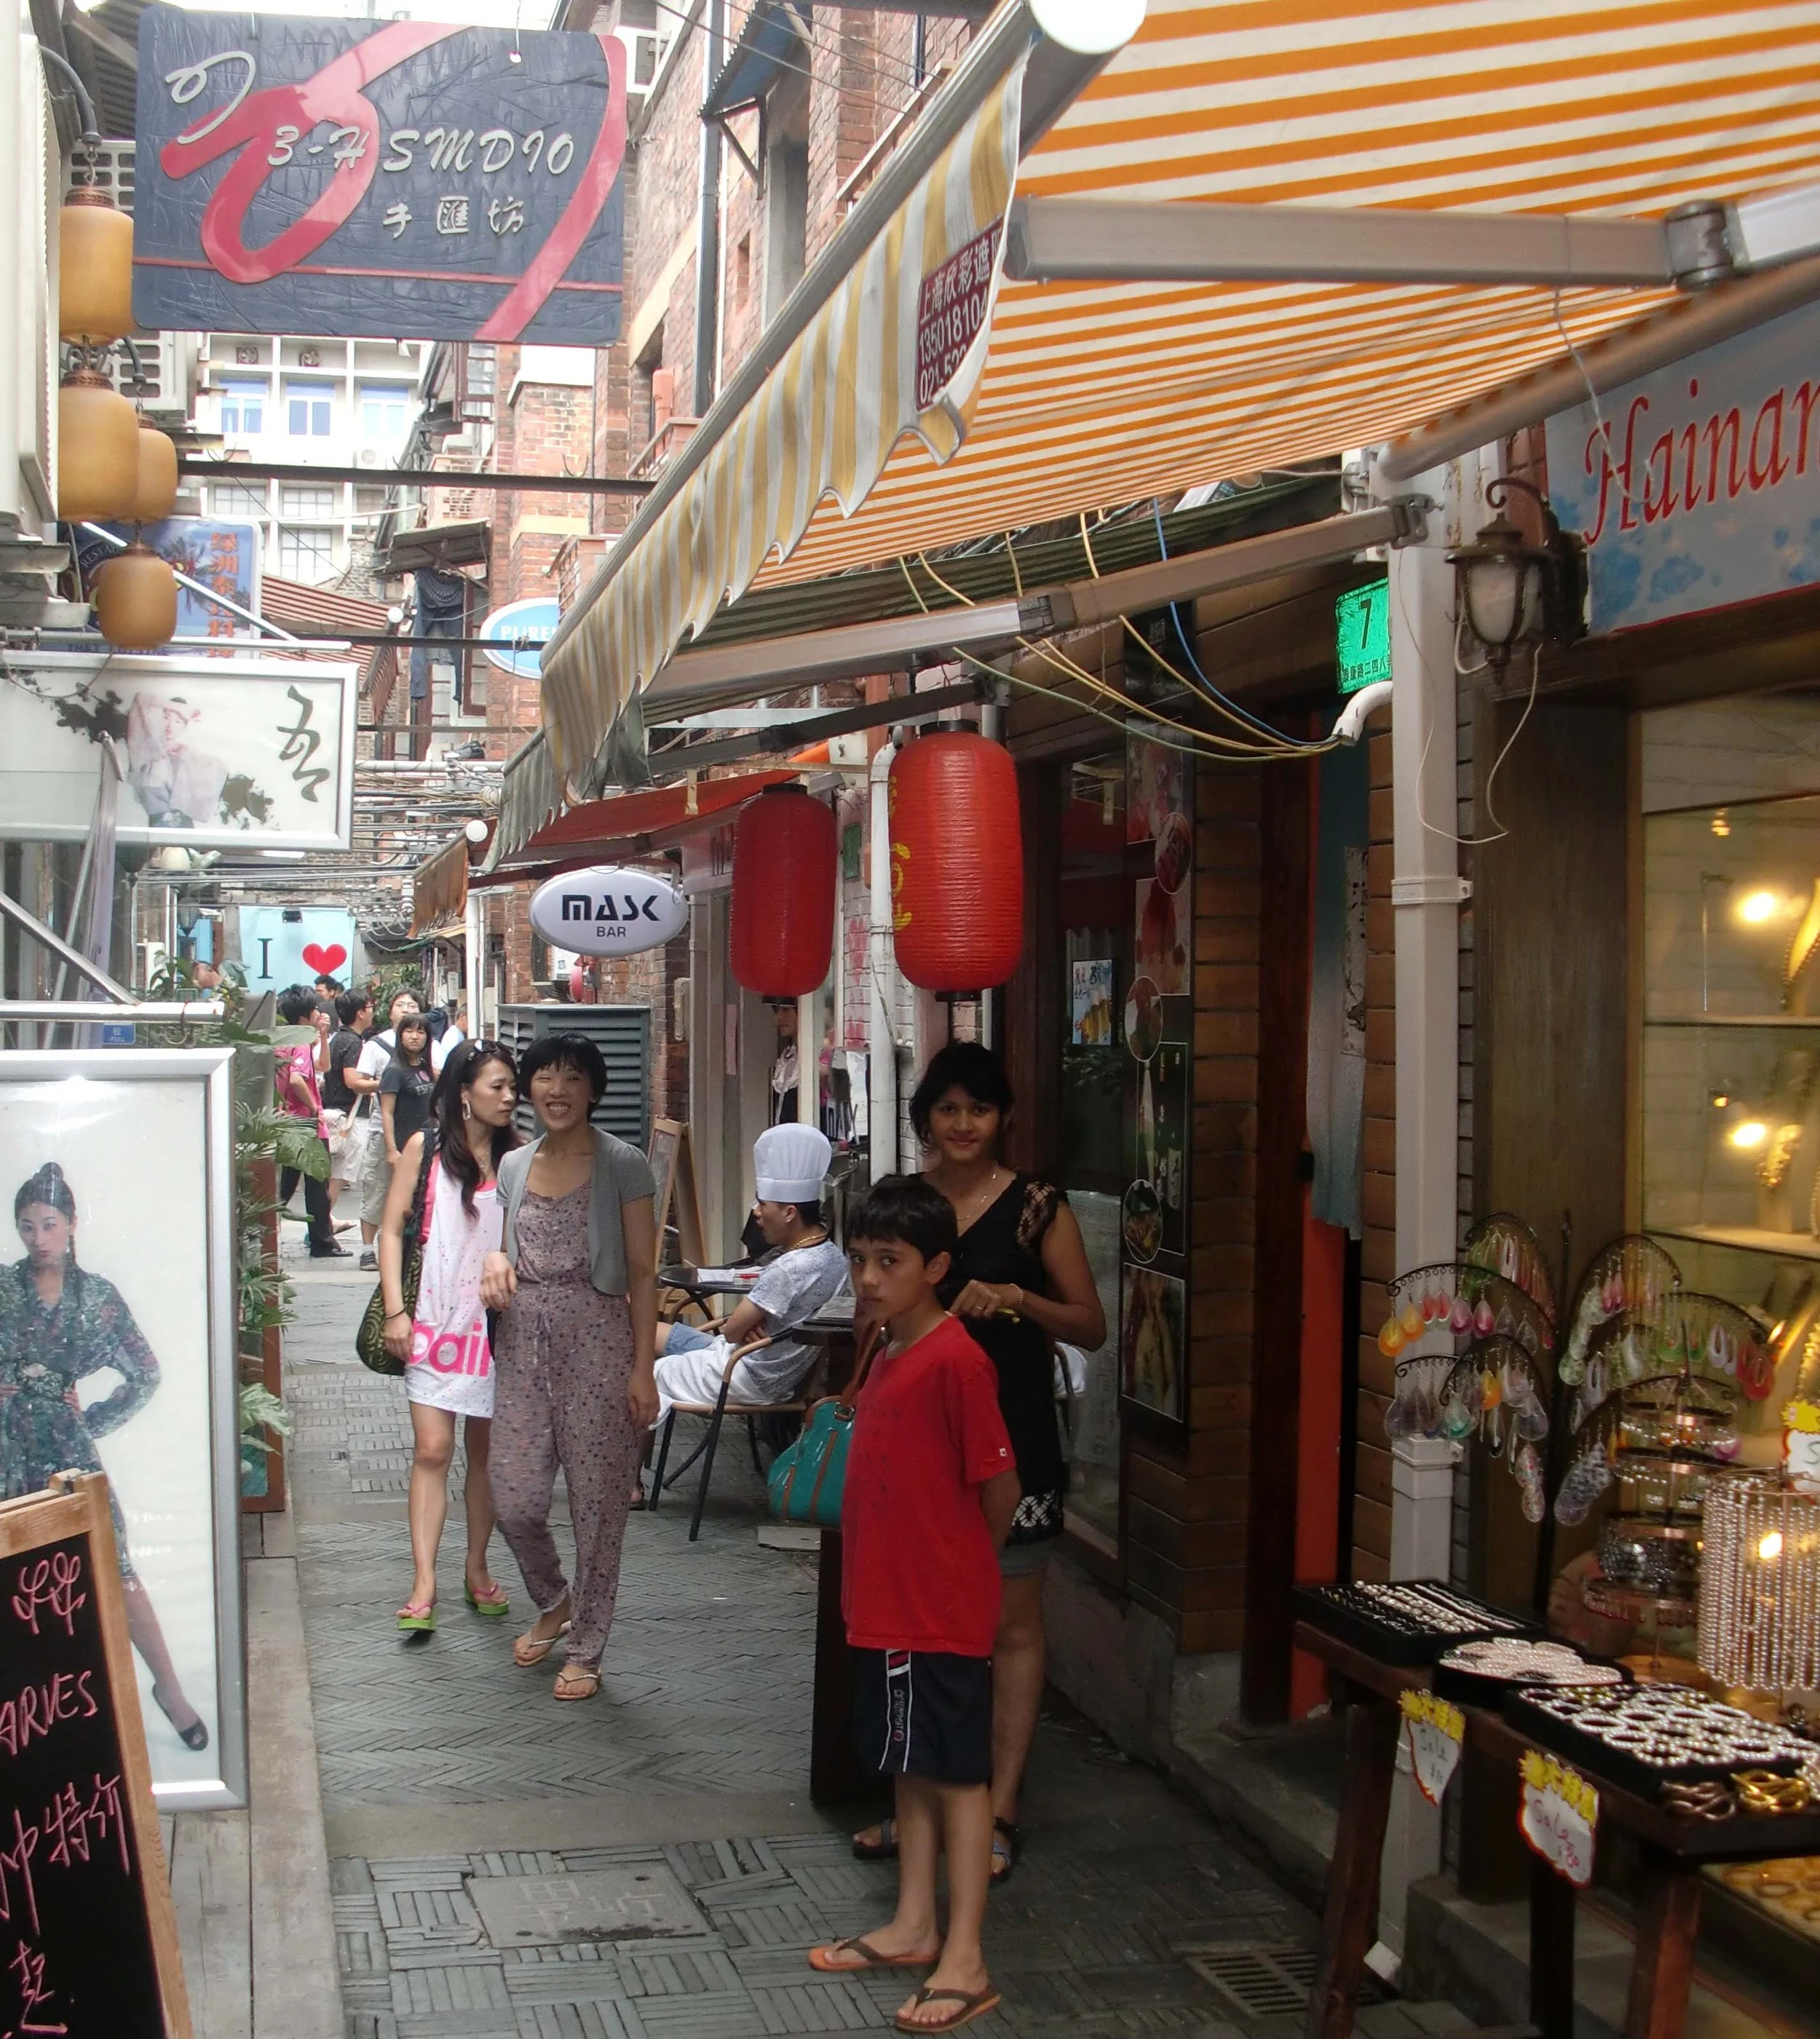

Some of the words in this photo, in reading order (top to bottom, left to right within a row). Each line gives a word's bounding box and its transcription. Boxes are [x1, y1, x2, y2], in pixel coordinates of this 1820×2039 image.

[1360, 598, 1372, 650] 7
[561, 894, 661, 922] MASK
[596, 926, 627, 938] BAR
[257, 938, 273, 979] I
